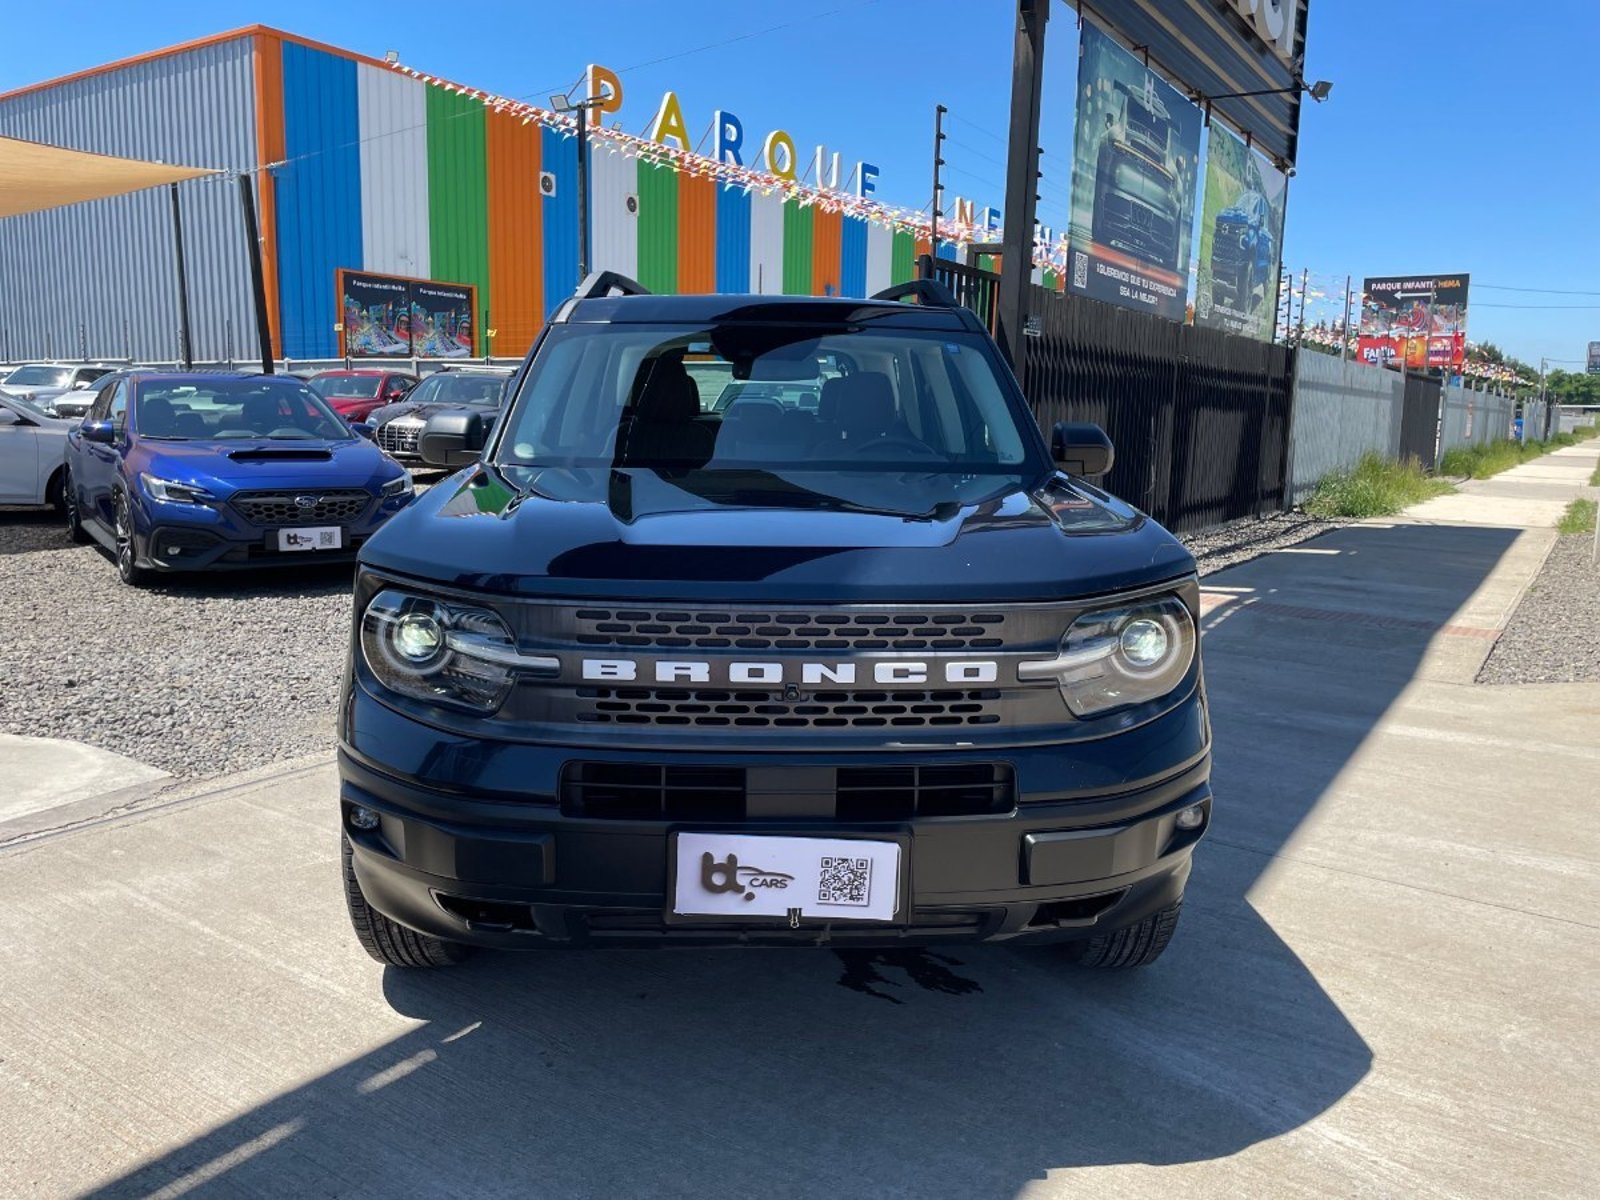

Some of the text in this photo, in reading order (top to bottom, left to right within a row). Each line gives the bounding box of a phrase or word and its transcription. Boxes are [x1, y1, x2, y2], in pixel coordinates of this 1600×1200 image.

[586, 63, 880, 198] PARQUE
[1130, 274, 1141, 286] QUE
[1142, 278, 1149, 289] TU
[1371, 282, 1401, 291] PARQUE
[1119, 285, 1130, 297] SEA
[1131, 289, 1138, 299] LA
[582, 659, 998, 684] BRONCO
[749, 877, 789, 890] CARS
